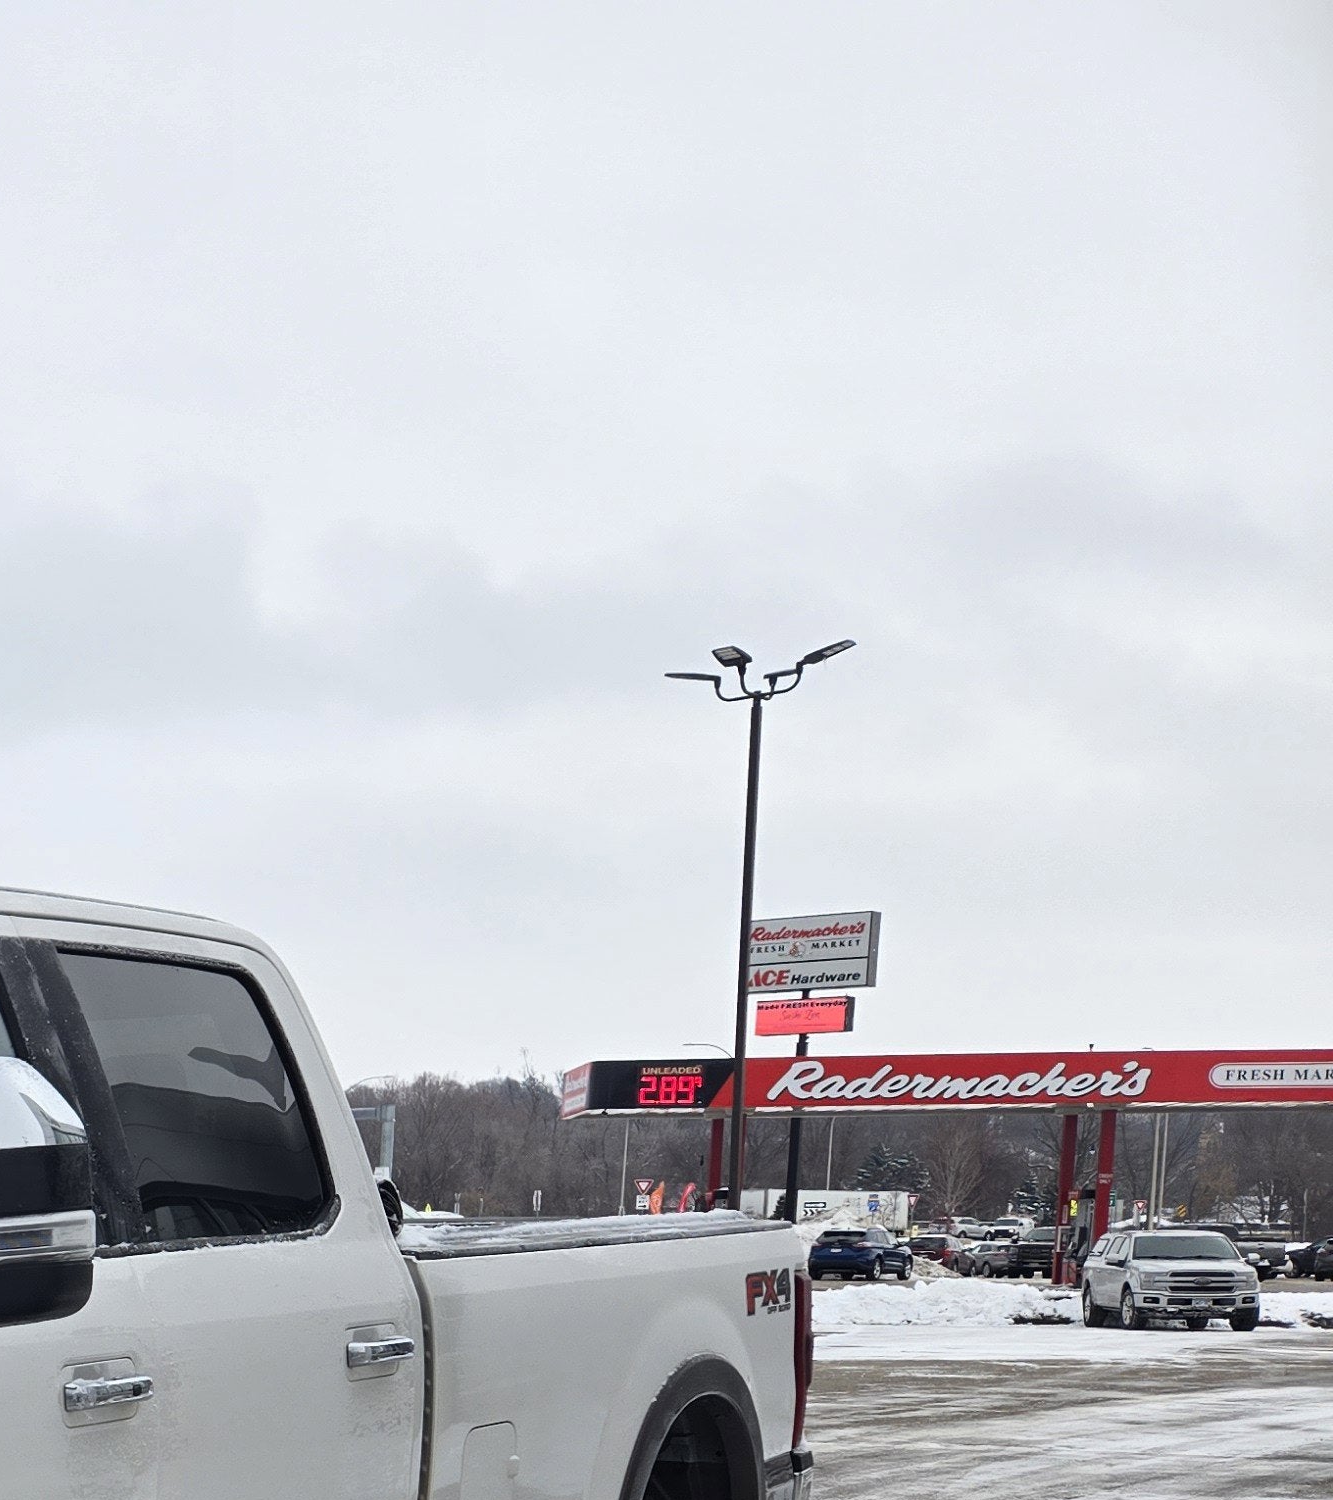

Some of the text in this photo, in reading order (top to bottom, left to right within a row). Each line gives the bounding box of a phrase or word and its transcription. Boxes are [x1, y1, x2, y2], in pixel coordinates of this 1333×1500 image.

[750, 921, 867, 942] Radermacher's
[811, 939, 861, 949] MARKET
[747, 969, 861, 988] ACE Hardware
[642, 1065, 702, 1075] UNLEADED
[1225, 1069, 1285, 1081] FRESH
[767, 1060, 1151, 1101] Radermacher's
[745, 1267, 791, 1316] FX4
